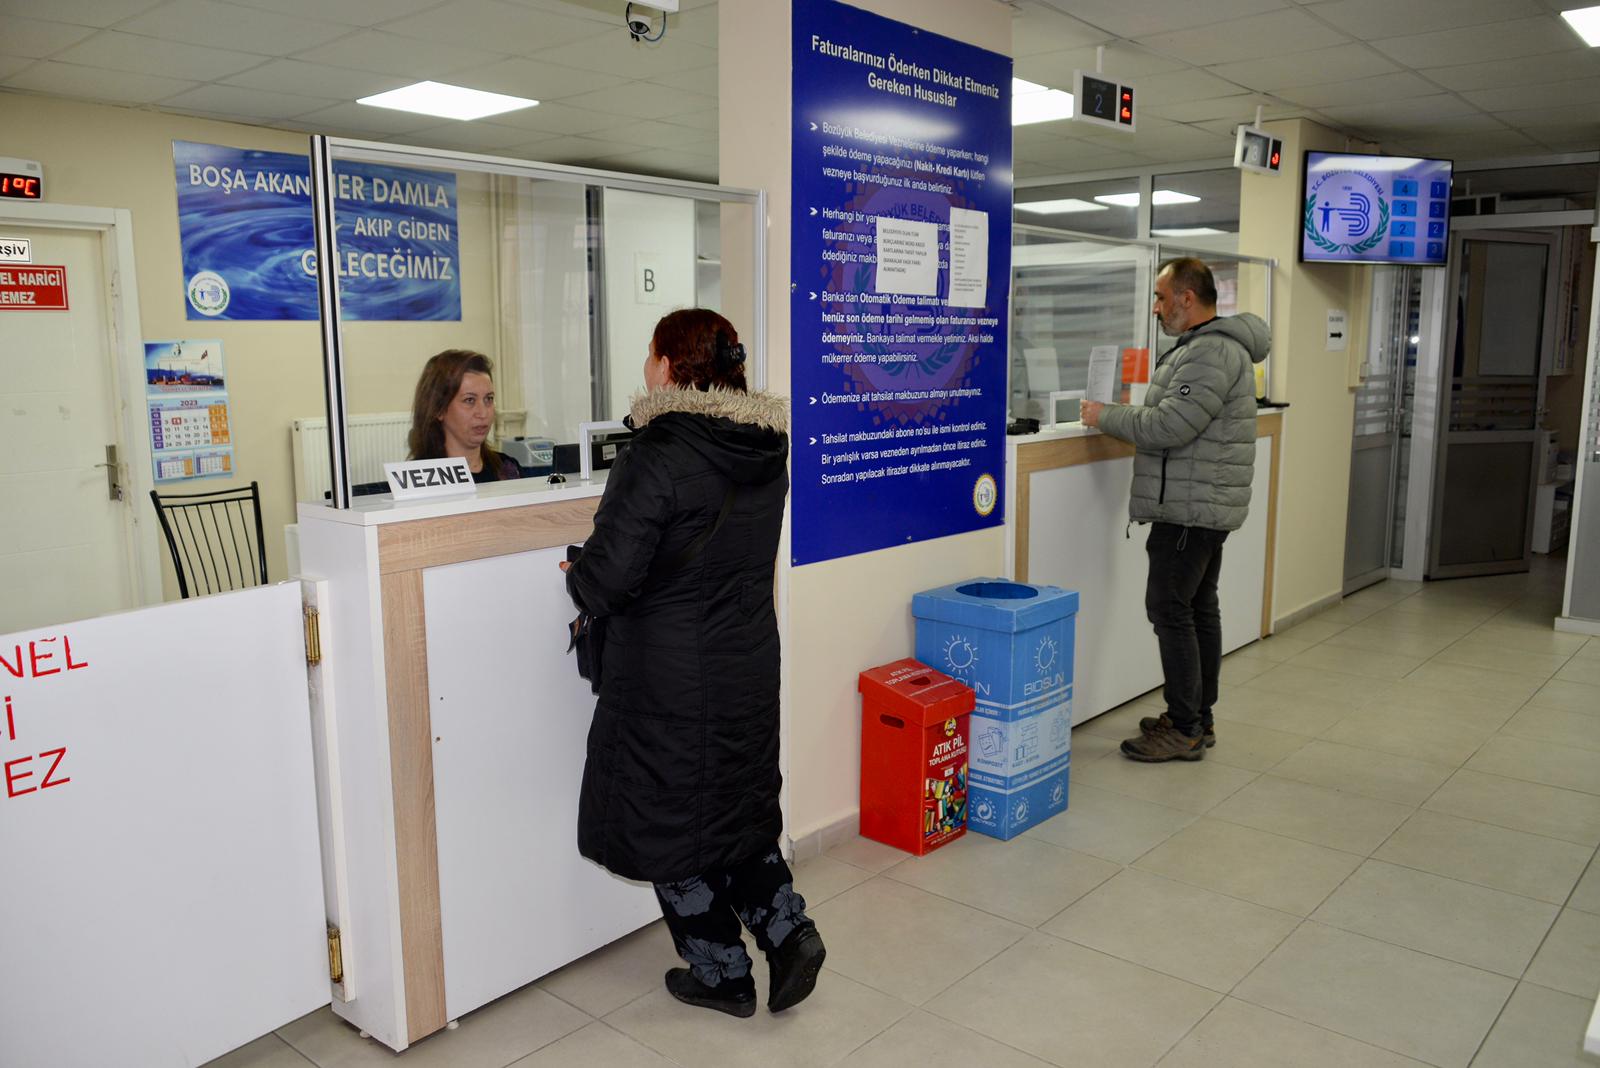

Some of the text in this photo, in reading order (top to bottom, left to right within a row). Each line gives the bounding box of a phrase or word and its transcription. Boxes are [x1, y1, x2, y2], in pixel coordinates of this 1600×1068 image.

[812, 35, 999, 99] Faturalarınızı Öderken Dikkat Etmeniz
[868, 72, 957, 108] Gereken Hususlar
[822, 122, 854, 138] Bozüyük
[822, 145, 848, 158] şekilde
[849, 149, 872, 162] ödeme
[936, 164, 953, 176] Kredi
[190, 164, 248, 194] BOŞA
[254, 171, 311, 197] AKAN
[373, 178, 449, 208] DAMLA
[822, 167, 852, 181] vezneye
[853, 170, 902, 187] başvurduğunuz
[911, 180, 927, 191] anda
[1402, 184, 1409, 194] 4
[822, 208, 855, 224] Herhangi
[856, 210, 864, 221] bir
[1401, 204, 1408, 214] 3
[354, 217, 450, 241] AKIP GİDEN
[822, 228, 855, 242] faturanızı
[857, 234, 872, 245] veya
[1400, 224, 1407, 234] 2
[302, 247, 452, 281] GLECEĞİMİZ
[822, 250, 857, 264] ödediğiniz
[18, 270, 61, 287] HARİCİ
[644, 268, 655, 293] B
[860, 292, 891, 304] Otomatik
[822, 312, 845, 323] henüz
[846, 314, 860, 323] son
[861, 313, 885, 324] ödeme
[886, 313, 903, 324] tarihi
[936, 314, 949, 324] olan
[867, 333, 894, 344] Bankaya
[895, 333, 916, 343] talimat
[822, 352, 852, 364] mükerrer
[854, 352, 877, 363] ödeme
[822, 391, 860, 404] Ödemenize
[861, 392, 870, 402] ait
[871, 391, 894, 402] tahsilat
[895, 390, 929, 400] makbuzunu
[822, 432, 848, 444] Tahsilat
[849, 427, 895, 442] makbuzundaki
[895, 426, 914, 438] abone
[939, 423, 951, 433] ismi
[822, 454, 832, 466] Bir
[861, 450, 879, 461] varsa
[880, 446, 910, 458] vezneden
[942, 441, 956, 451] önce
[392, 465, 469, 489] VEZNE
[822, 472, 854, 485] Sonradan
[855, 467, 886, 482] yapılacak
[909, 462, 930, 473] dikkate
[1024, 671, 1065, 696] BIOSUN
[932, 734, 964, 758] ATIK PİL
[929, 753, 951, 767] TOPLAMA
